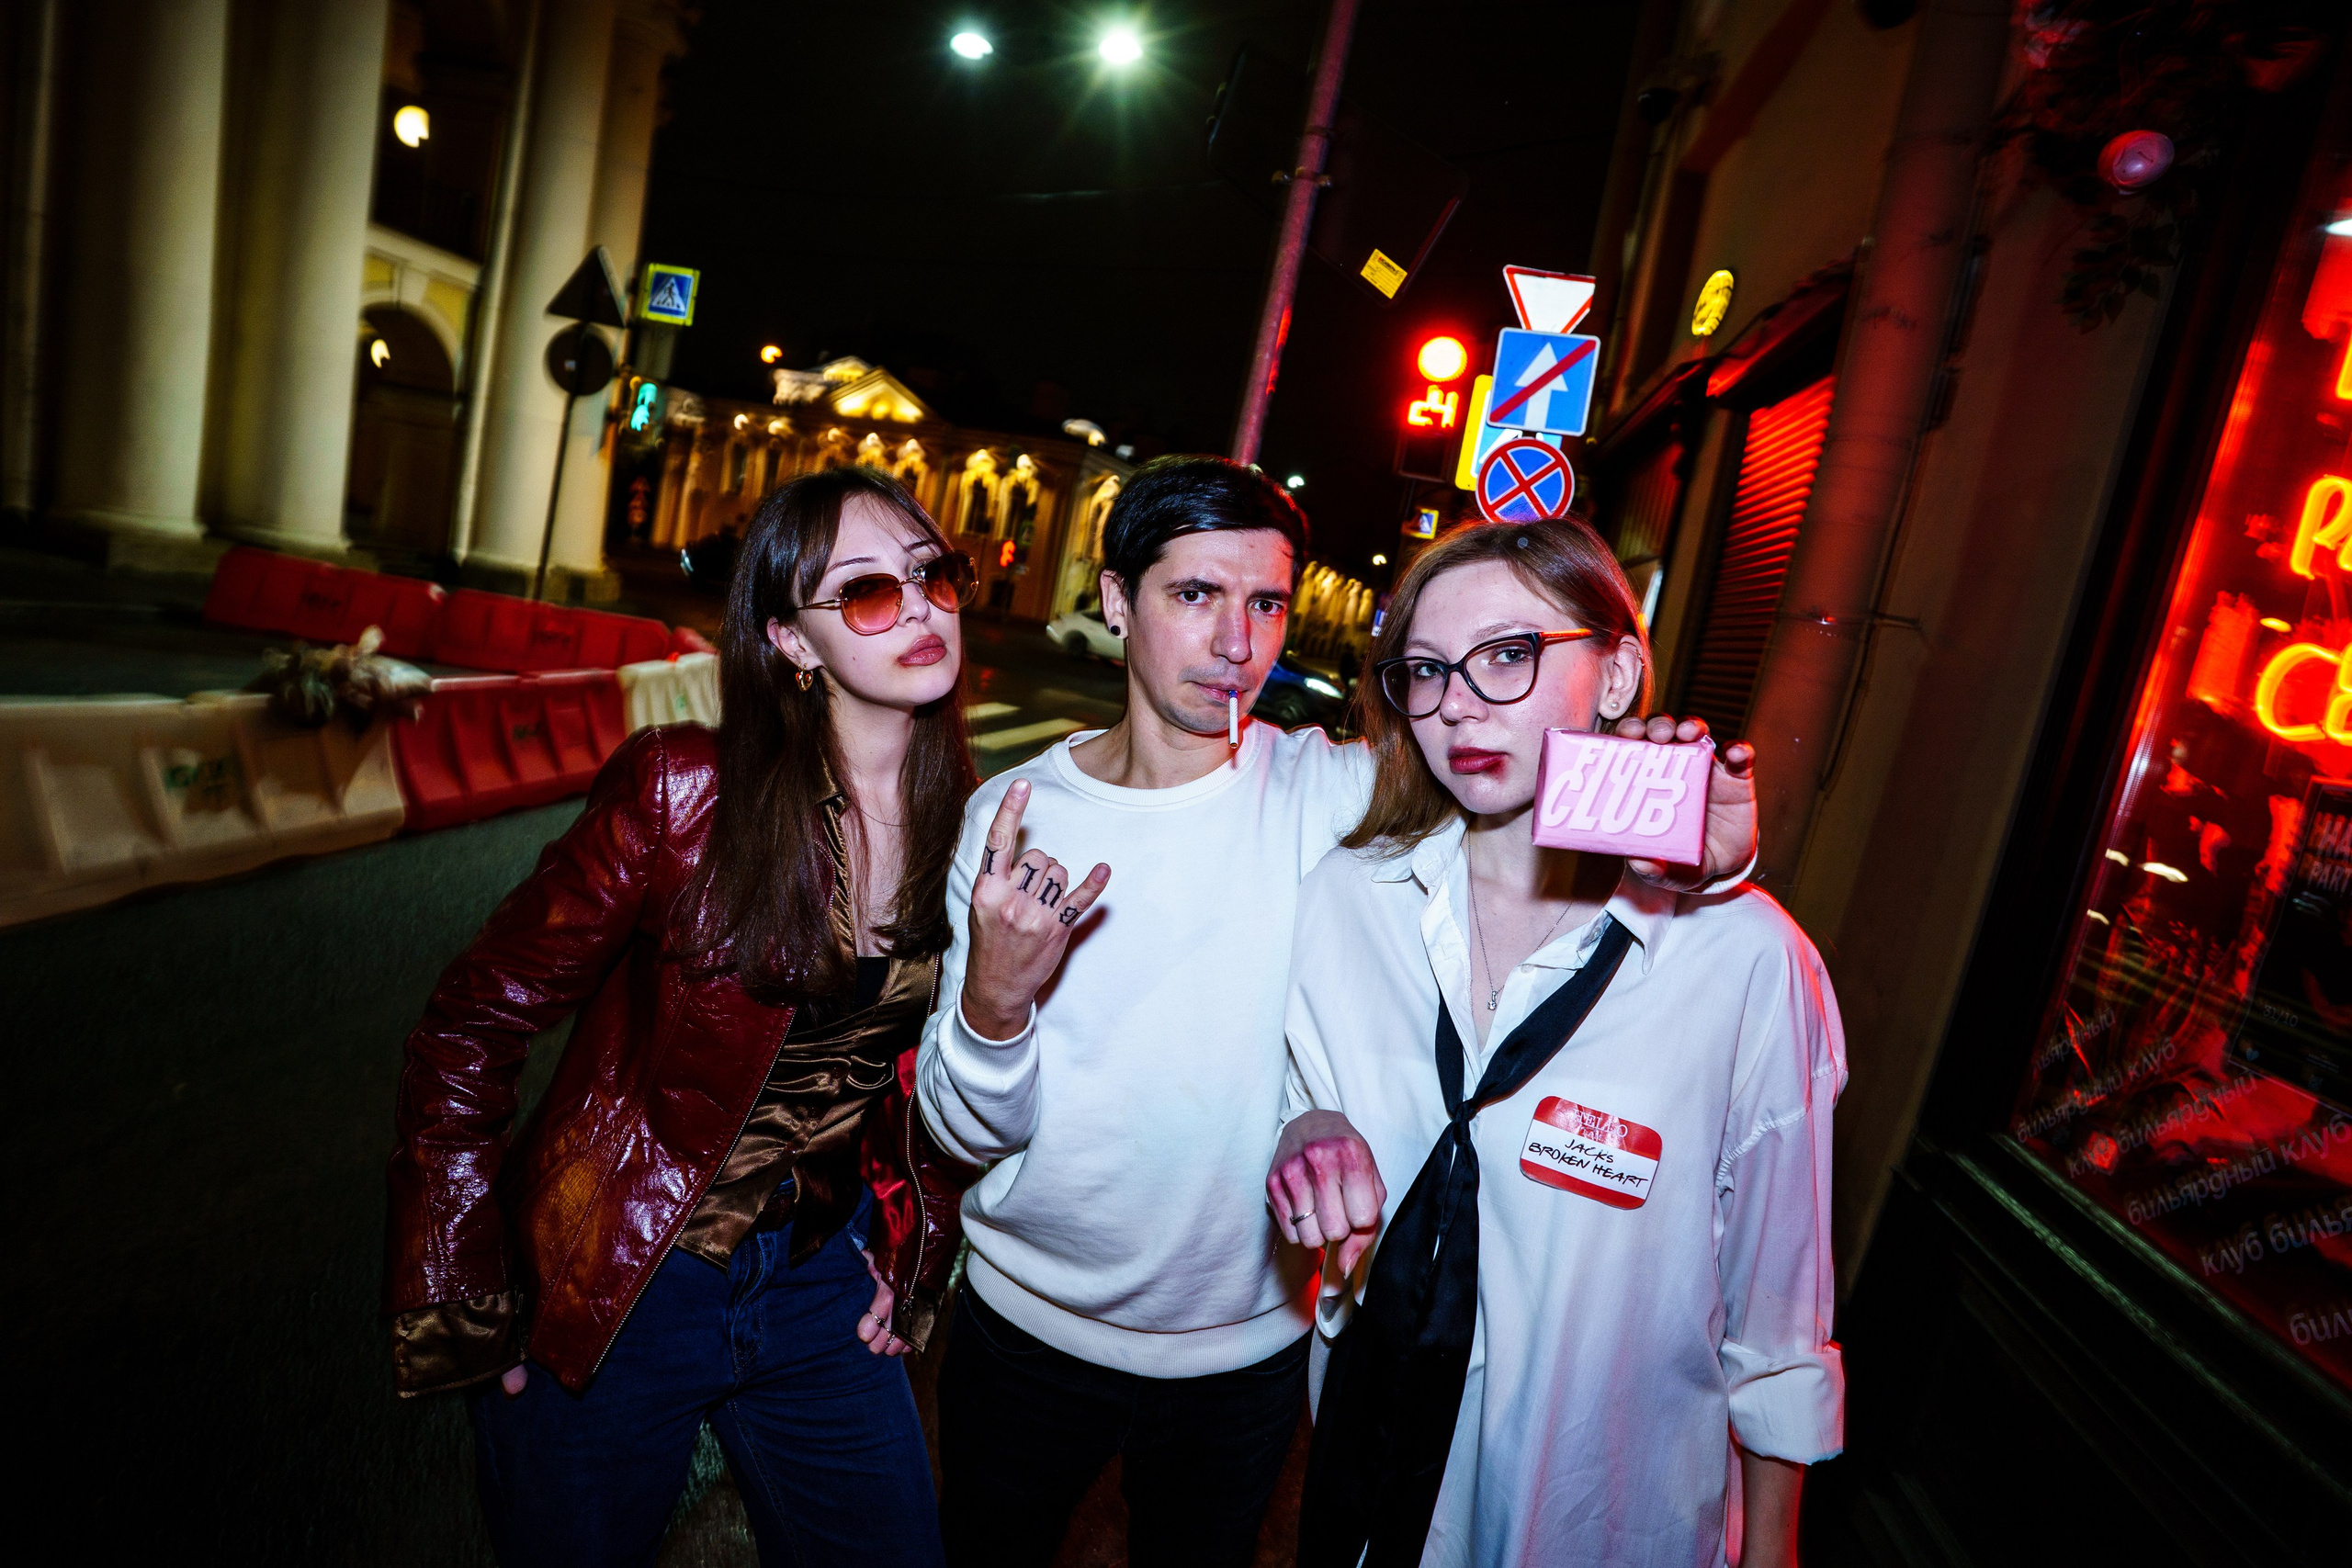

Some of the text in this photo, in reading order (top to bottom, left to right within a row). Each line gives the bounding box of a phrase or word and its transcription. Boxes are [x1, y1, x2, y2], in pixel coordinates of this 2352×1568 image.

[1572, 738, 1699, 781] FIGHT
[1539, 770, 1689, 837] CLUB
[2016, 1036, 2177, 1145] бильярдный клуб
[2116, 1068, 2258, 1155] бильярдный
[1528, 1142, 1649, 1188] BROKEN HEART
[1565, 1138, 1614, 1164] JACKS
[2127, 1112, 2352, 1226] бильярдный клуб
[2200, 1230, 2265, 1277] клуб
